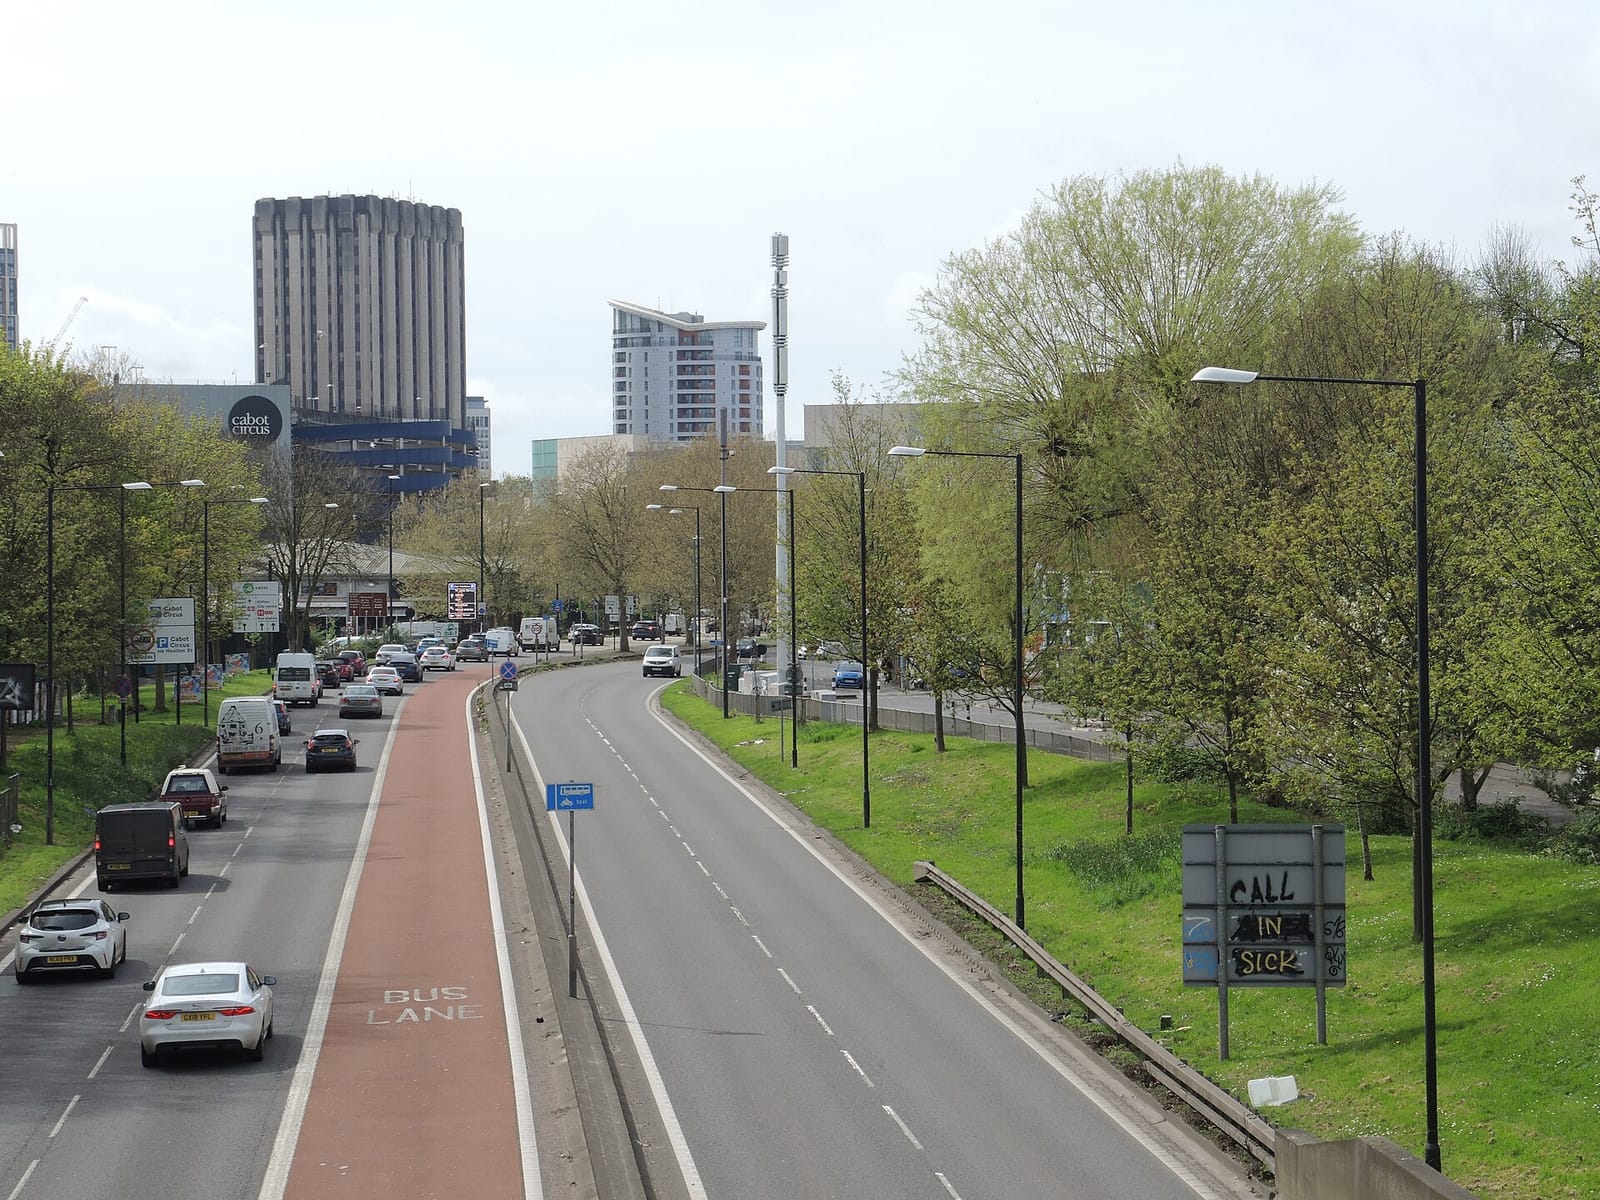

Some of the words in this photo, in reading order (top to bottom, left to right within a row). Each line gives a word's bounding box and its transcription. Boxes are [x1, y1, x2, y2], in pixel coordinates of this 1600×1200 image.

[231, 412, 270, 425] cabot
[231, 425, 271, 435] circus
[1230, 871, 1295, 903] CALL
[1258, 916, 1282, 937] IN
[1241, 950, 1297, 974] SICK
[384, 986, 468, 1004] BUS
[366, 1004, 485, 1025] LANE
